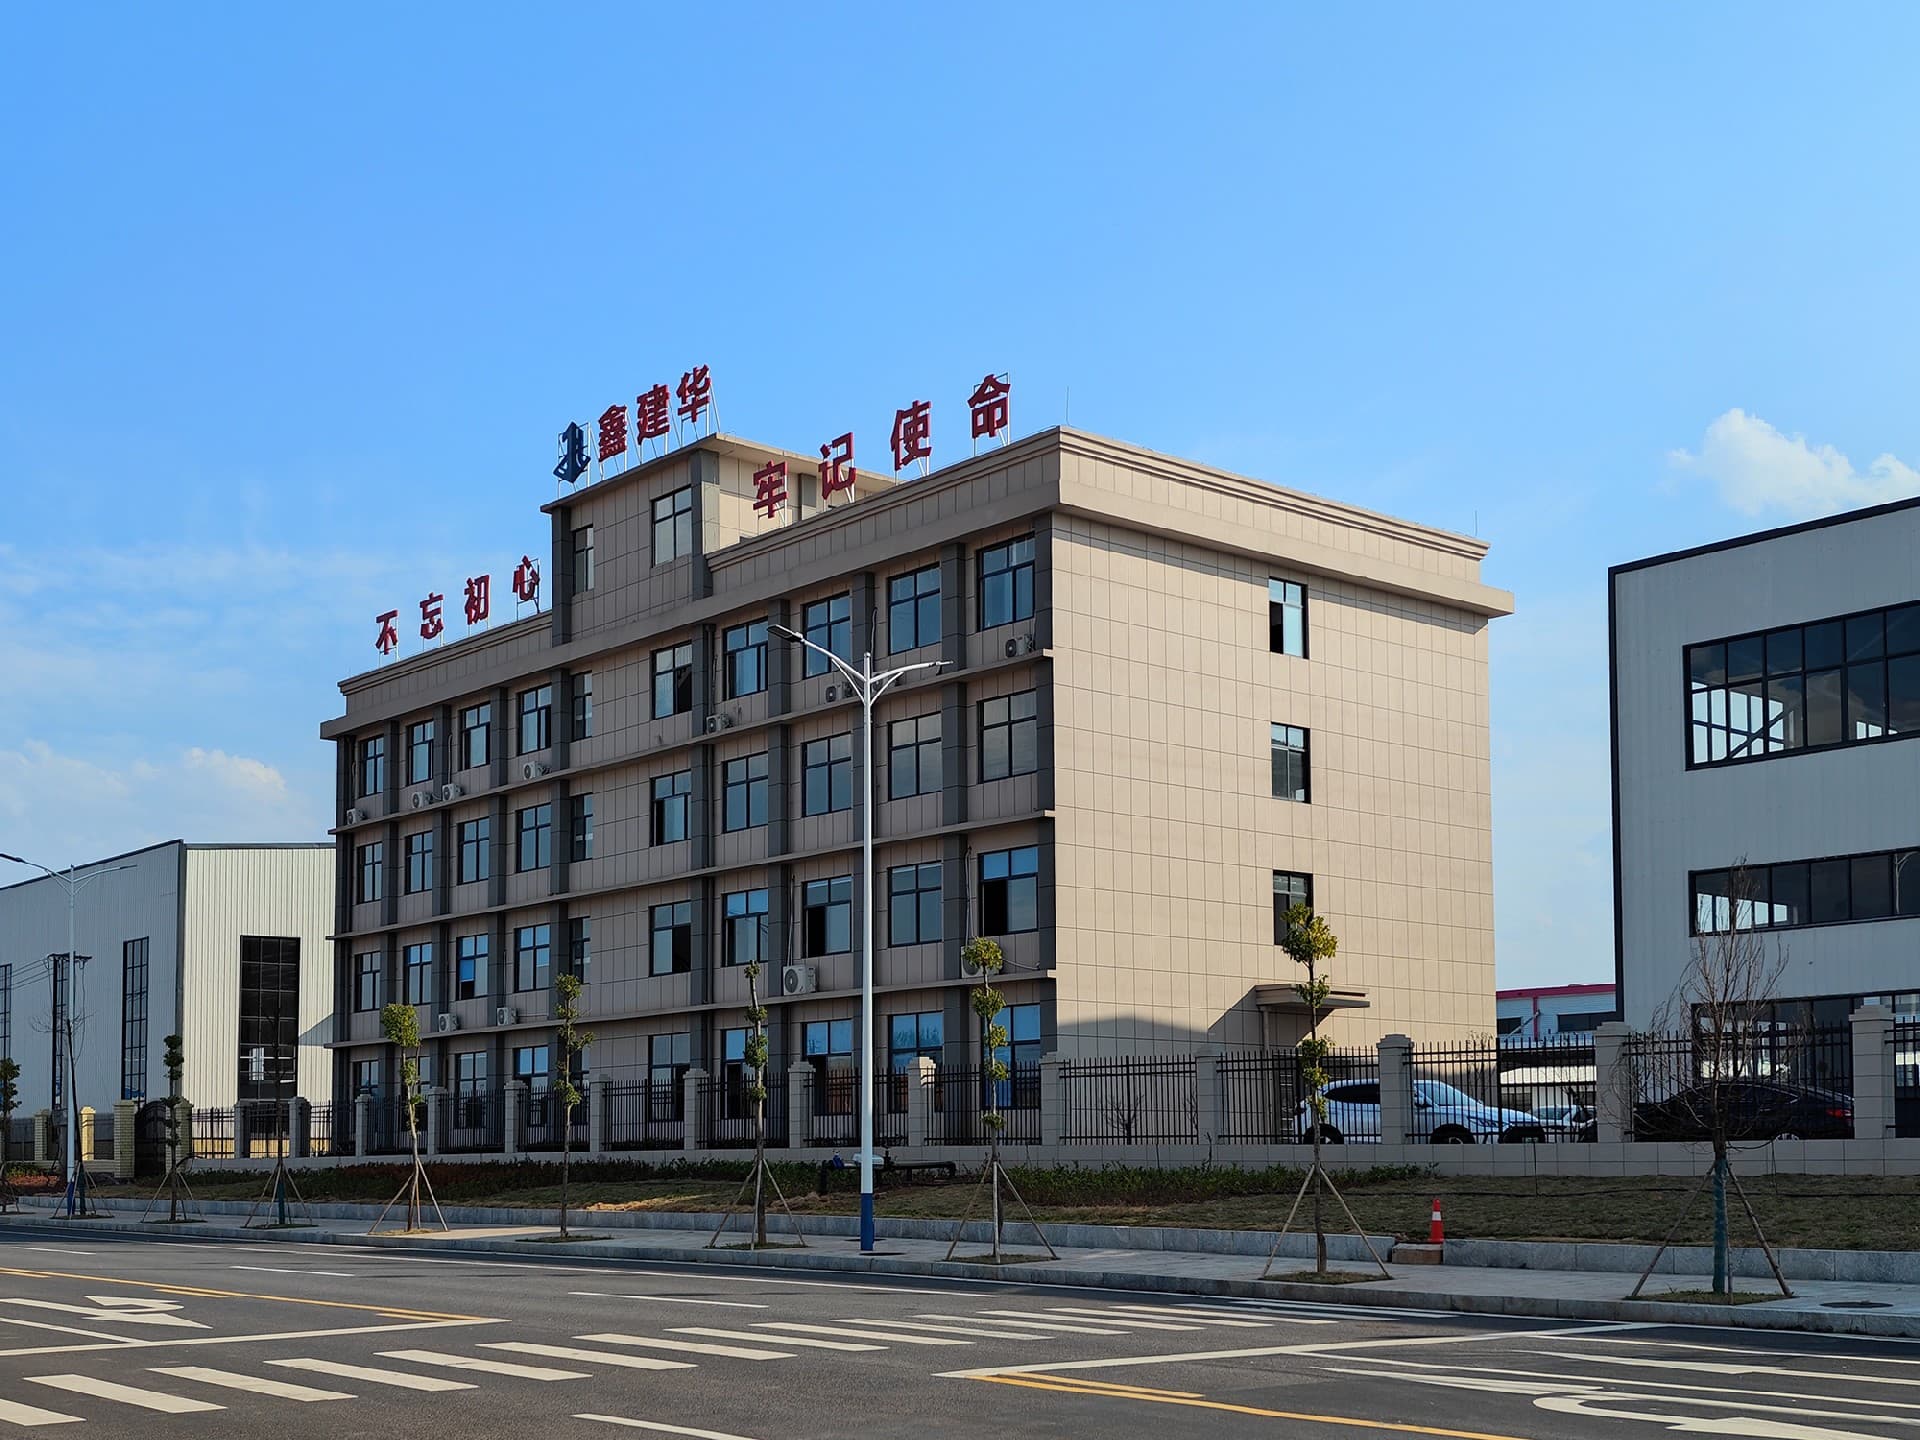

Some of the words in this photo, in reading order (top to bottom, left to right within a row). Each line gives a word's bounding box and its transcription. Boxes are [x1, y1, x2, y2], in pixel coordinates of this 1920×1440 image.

[598, 364, 711, 462] 鑫建华
[753, 374, 1011, 519] 牢记使命
[376, 555, 540, 655] 不忘初心
